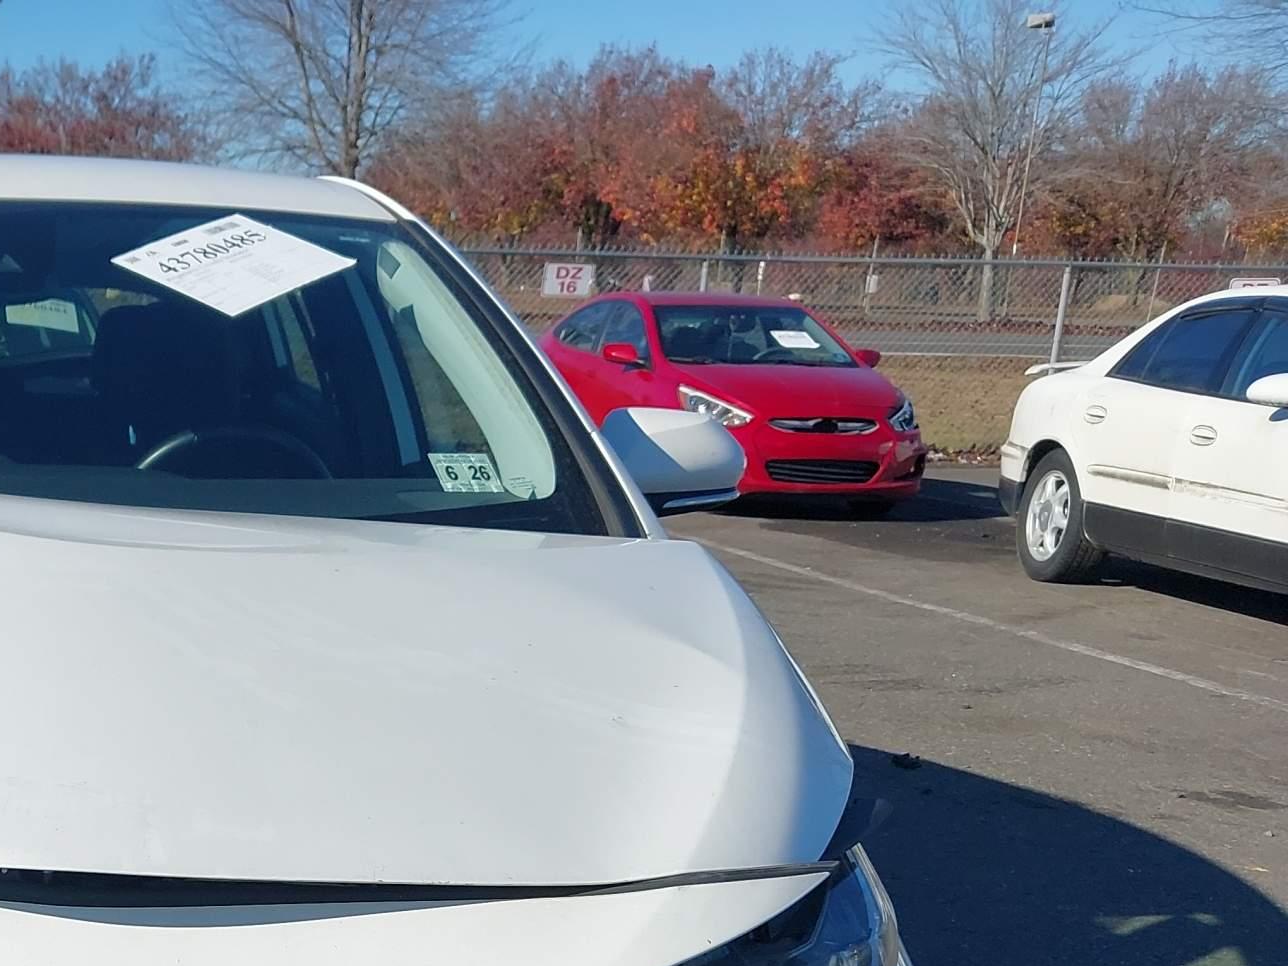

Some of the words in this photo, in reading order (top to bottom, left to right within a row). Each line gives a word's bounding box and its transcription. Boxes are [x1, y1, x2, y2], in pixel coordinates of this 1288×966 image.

[158, 229, 267, 274] 43780485
[556, 266, 584, 280] DZ
[558, 281, 577, 294] 16
[444, 465, 459, 481] 6
[467, 465, 492, 481] 26
